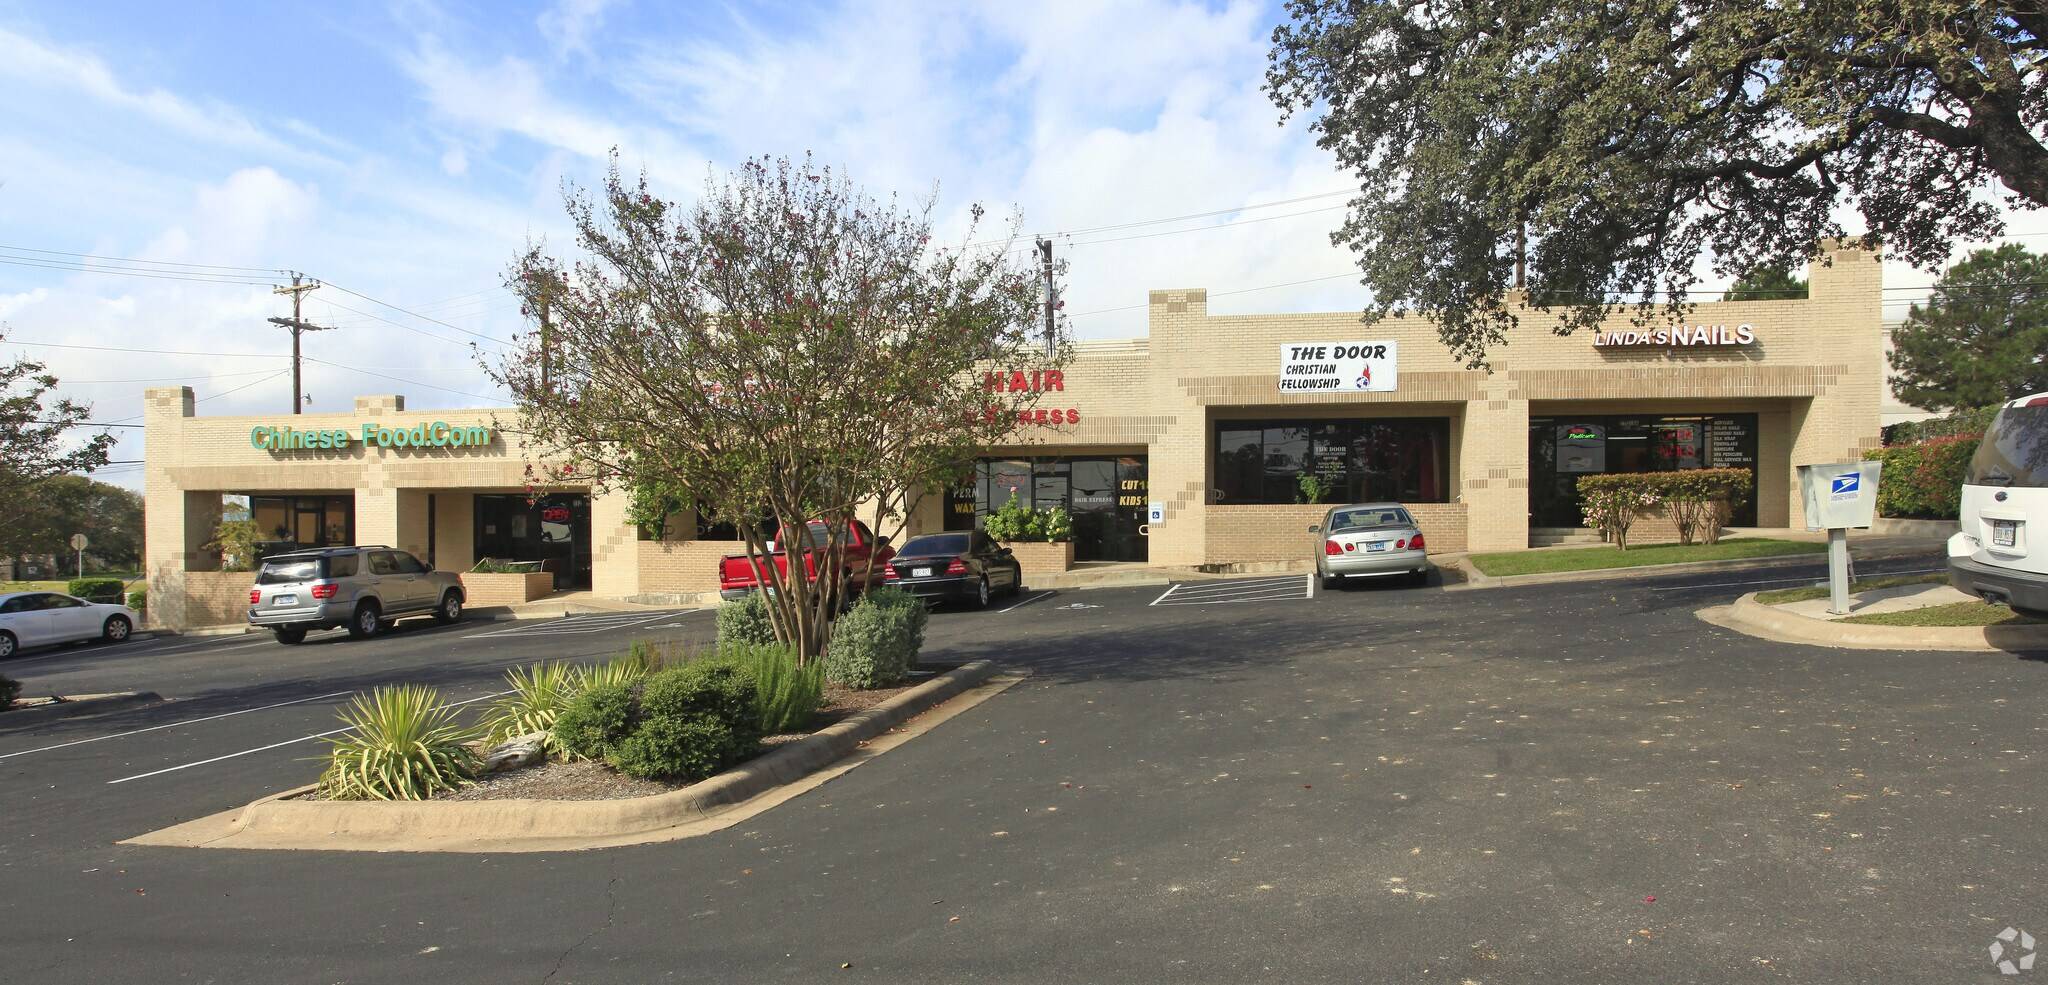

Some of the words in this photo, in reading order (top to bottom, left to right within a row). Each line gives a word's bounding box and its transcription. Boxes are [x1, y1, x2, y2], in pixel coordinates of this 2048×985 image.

[1594, 330, 1667, 346] LINDA'S
[1671, 323, 1754, 346] NAILS
[1291, 346, 1327, 360] THE
[1333, 345, 1386, 360] DOOR
[1286, 364, 1337, 375] CHRISTIAN
[983, 369, 1065, 393] HAIR
[1281, 378, 1341, 389] FELLOWSHIP
[251, 425, 350, 449] Chinese
[361, 421, 491, 448] Food.Com
[1121, 480, 1139, 490] CUT
[953, 487, 979, 498] PERM
[1120, 496, 1142, 506] KIDS
[954, 503, 975, 513] WAX
